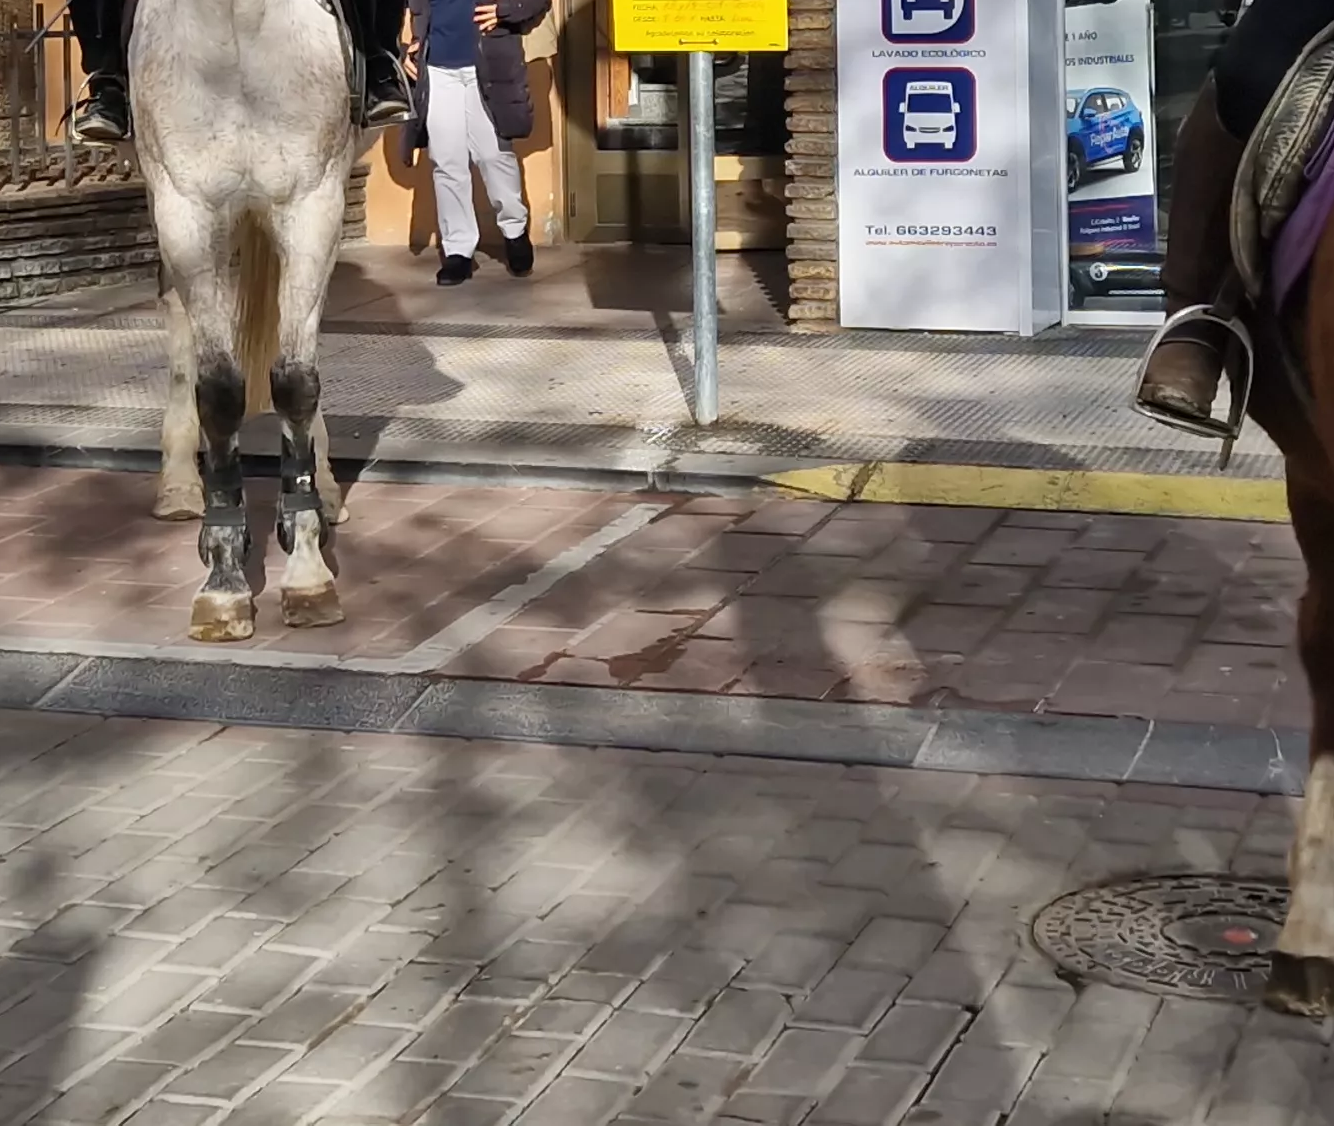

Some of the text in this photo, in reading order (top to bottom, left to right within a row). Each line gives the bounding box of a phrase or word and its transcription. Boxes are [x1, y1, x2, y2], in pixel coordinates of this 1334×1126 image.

[872, 48, 986, 58] LAVADO ECOLÓGICO
[853, 168, 1009, 177] ALQUILER DE FURGONETAS
[864, 225, 998, 236] Tel. 663293443
